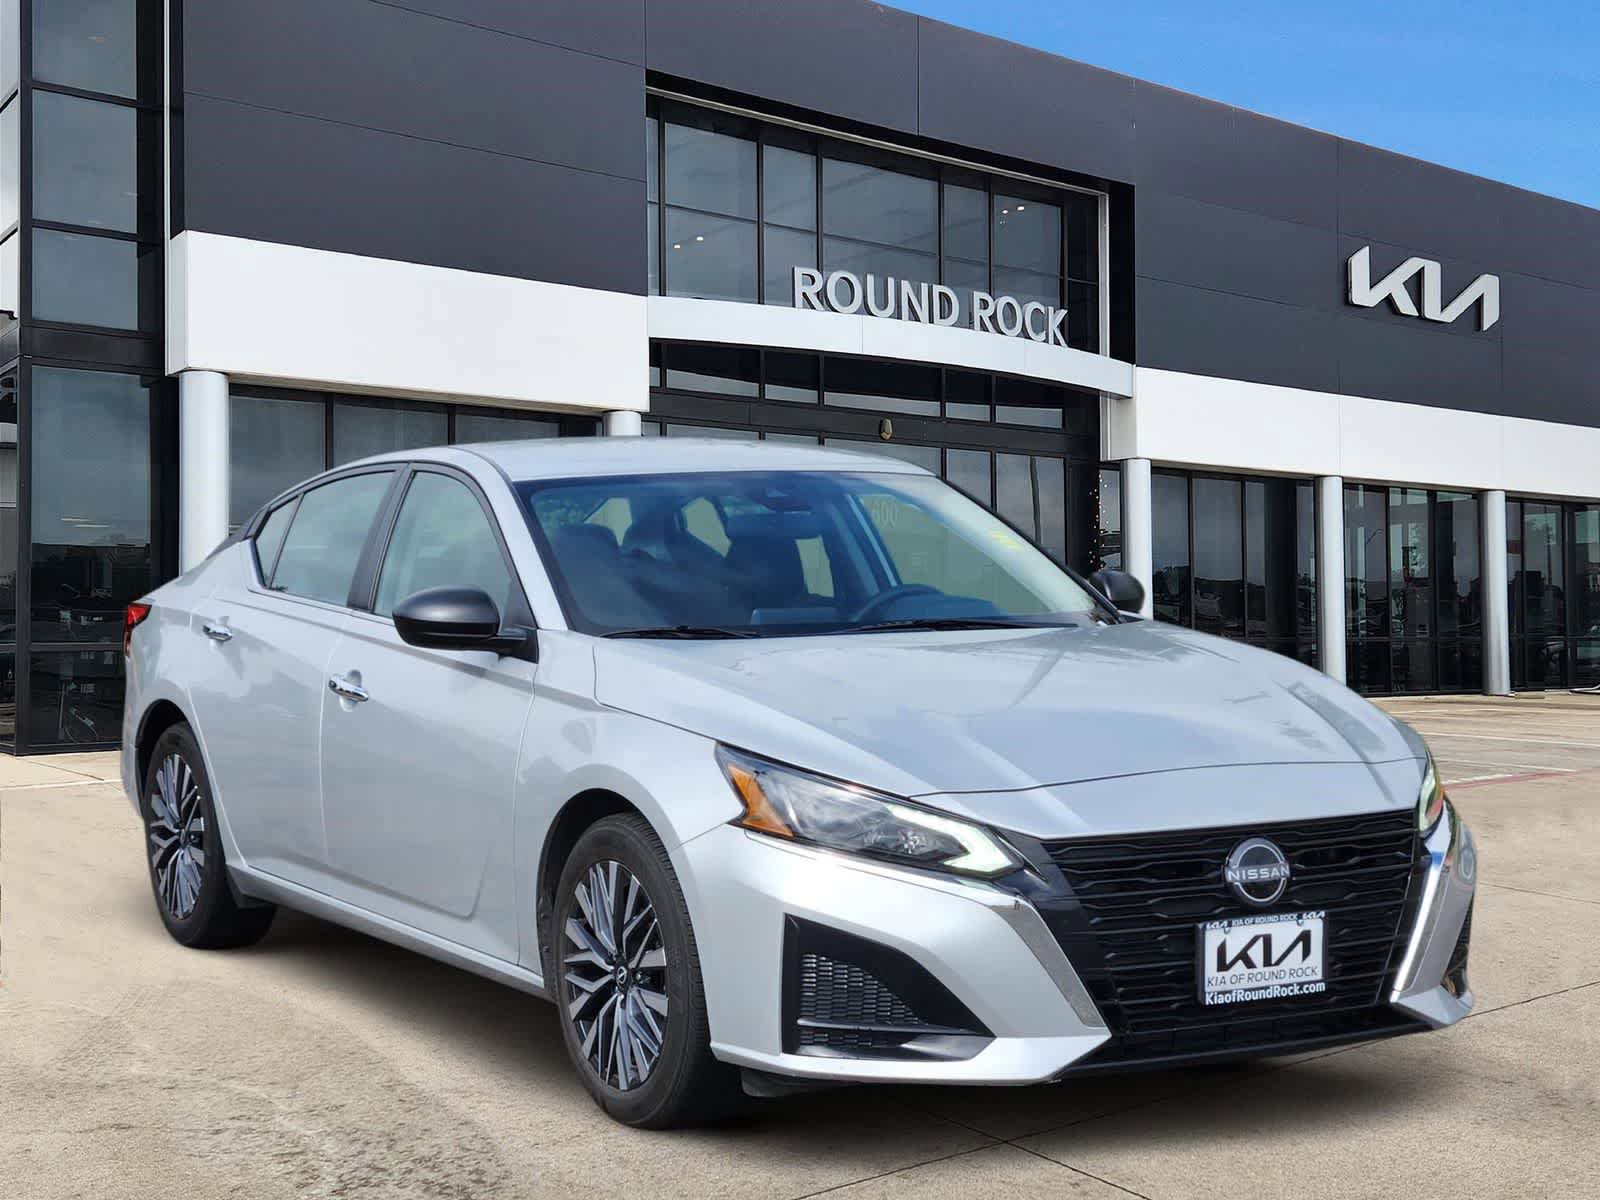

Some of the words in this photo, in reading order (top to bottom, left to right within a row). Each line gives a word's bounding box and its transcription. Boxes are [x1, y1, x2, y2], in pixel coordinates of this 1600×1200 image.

[1348, 246, 1500, 331] KIA
[793, 266, 960, 326] ROUND
[972, 290, 1068, 347] ROCK
[1228, 864, 1290, 881] NISSAN
[1245, 917, 1255, 926] OF
[1255, 914, 1279, 924] ROUND
[1280, 912, 1298, 922] ROCK
[1216, 929, 1312, 972] KIA
[1207, 976, 1227, 987] KIA
[1229, 973, 1245, 985] OF
[1247, 969, 1286, 983] ROUND
[1288, 966, 1318, 978] ROCK
[1205, 981, 1326, 1006] KiaofRoundRock.com
